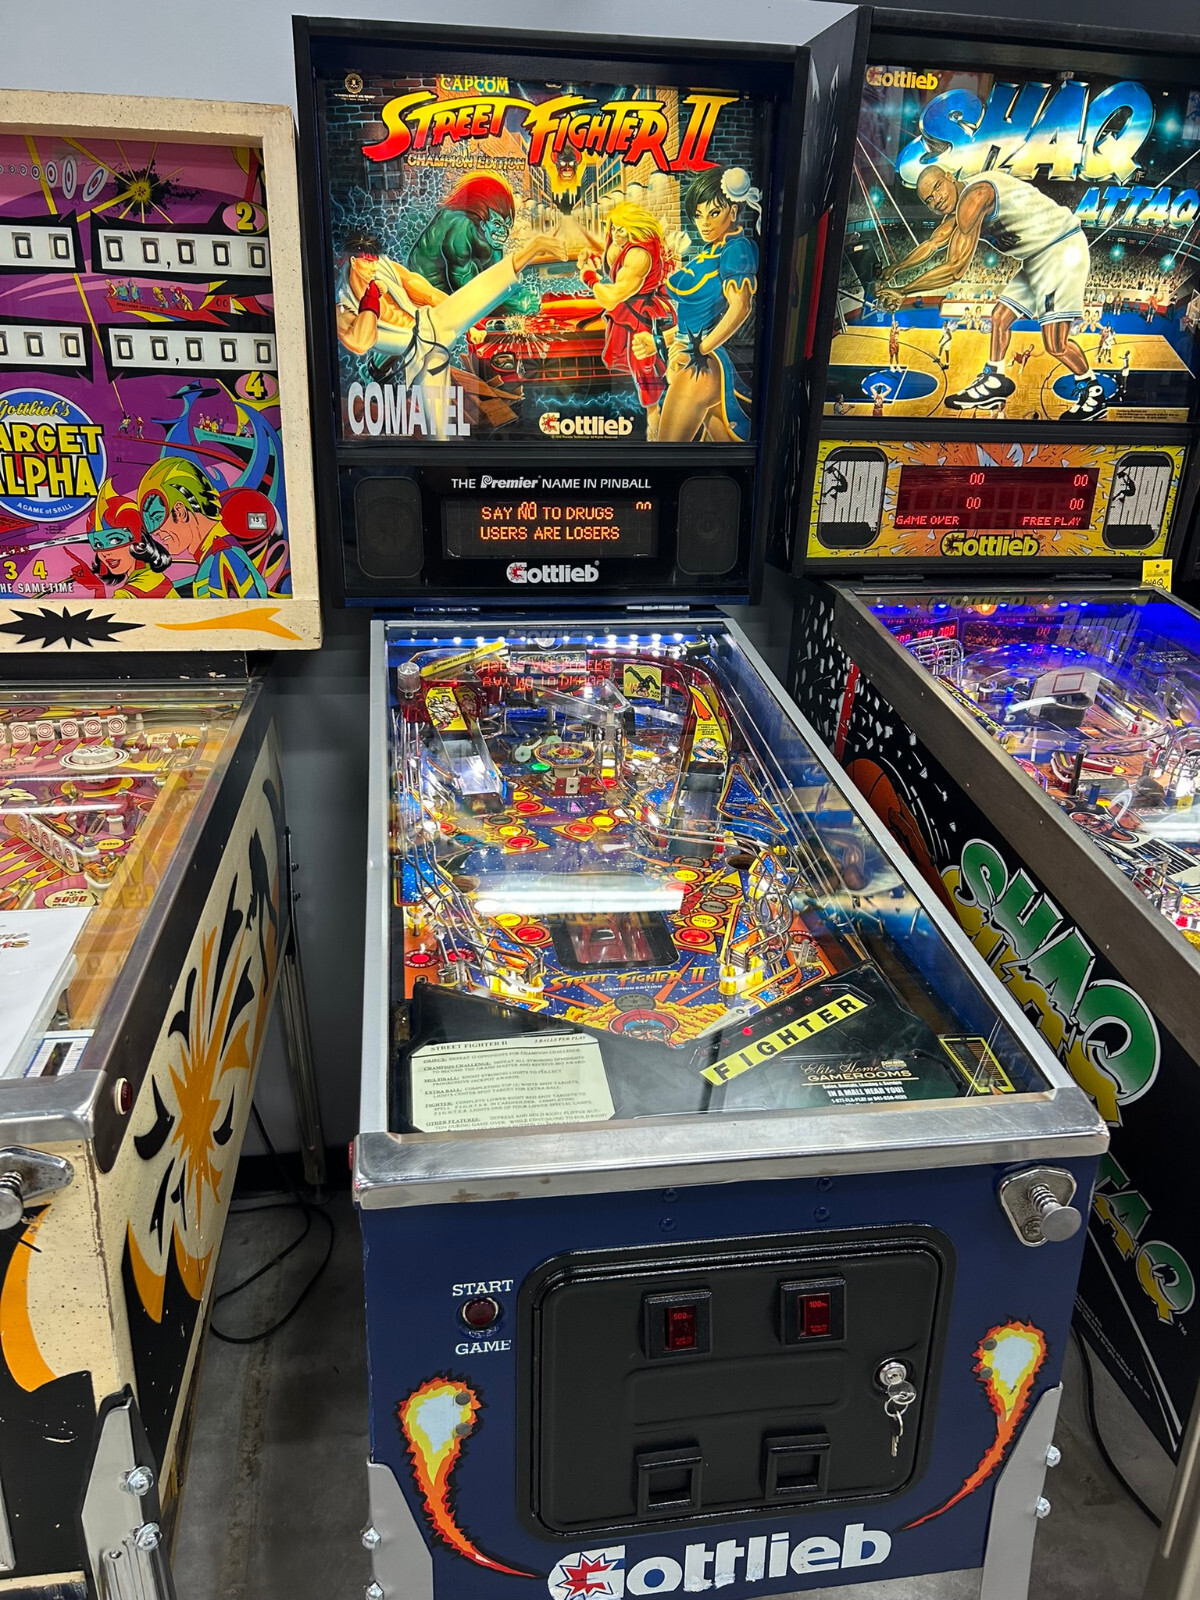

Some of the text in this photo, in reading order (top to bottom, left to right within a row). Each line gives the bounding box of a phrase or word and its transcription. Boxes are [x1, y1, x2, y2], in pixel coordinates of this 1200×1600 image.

[440, 77, 509, 93] CAPCOM
[866, 66, 938, 90] Gottlieb
[362, 91, 740, 171] STREET FIGHTER II
[895, 80, 1156, 188] SHAQ
[407, 155, 526, 171] CHAMPION EDITION
[236, 202, 254, 231] 2
[1073, 186, 1200, 229] ATTAQ
[245, 371, 266, 399] 4
[539, 412, 633, 436] Gottlieb
[0, 422, 103, 454] ARGET
[451, 475, 652, 489] THE Premier NAME IN PINBALL
[969, 473, 1089, 487] 00 00
[23, 504, 44, 514] GAME
[53, 503, 74, 514] SKILL
[966, 497, 1084, 511] 00 00
[481, 507, 513, 520] SAY
[543, 507, 562, 520] TO
[566, 507, 614, 520] DRUGS
[896, 515, 1081, 526] GAME OVER FREE PLAY
[480, 527, 620, 540] USERS ARE LOSERS
[941, 531, 1039, 557] Gottlieb
[3, 560, 48, 580] 3 4
[506, 562, 600, 584] Gottlieb
[0, 582, 74, 594] HE SAME TIME
[545, 973, 608, 991] STREET
[617, 970, 686, 988] FIGHTER
[941, 838, 1160, 1127] SHAQ
[800, 1061, 836, 1075] Elite
[839, 1060, 880, 1073] Home
[807, 1069, 912, 1082] GAMEROOMS
[844, 1088, 865, 1096] MALL
[864, 1087, 885, 1095] NEAR
[452, 1279, 514, 1297] START
[455, 1339, 512, 1355] GAME
[546, 1522, 892, 1600] Gottlieb
